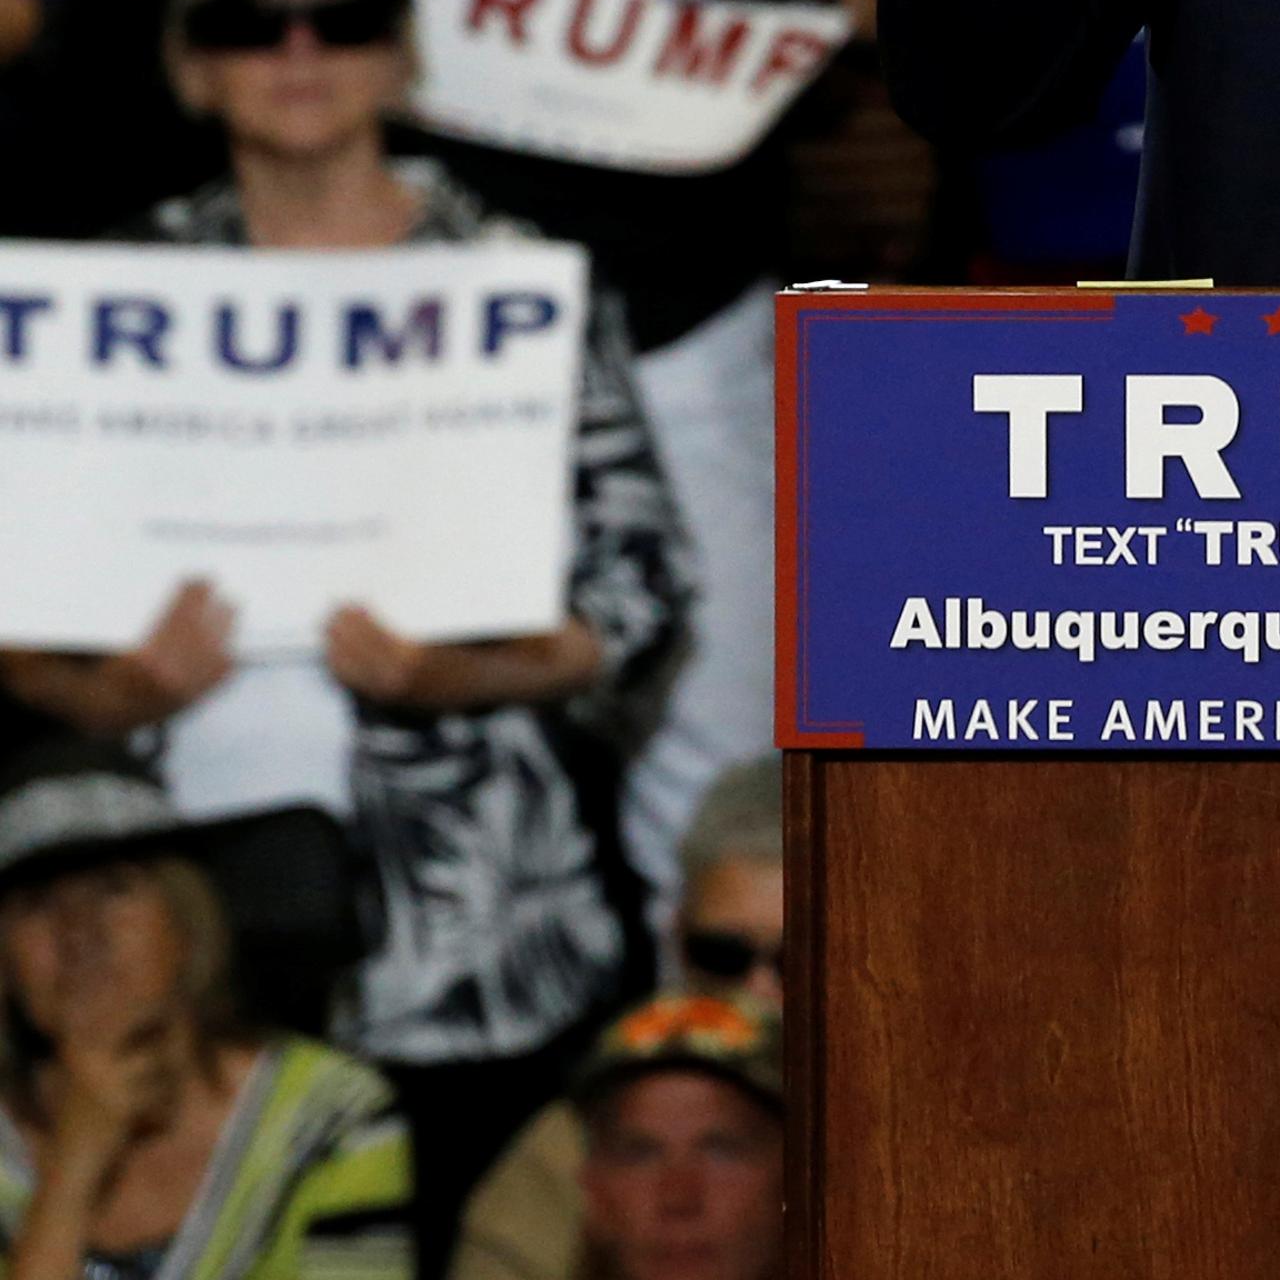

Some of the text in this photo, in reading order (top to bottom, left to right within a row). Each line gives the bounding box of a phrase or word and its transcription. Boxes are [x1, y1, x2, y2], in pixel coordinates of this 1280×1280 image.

[0, 291, 560, 374] TRUMP
[1043, 526, 1167, 566] TEXT
[913, 699, 1074, 741] MAKE
